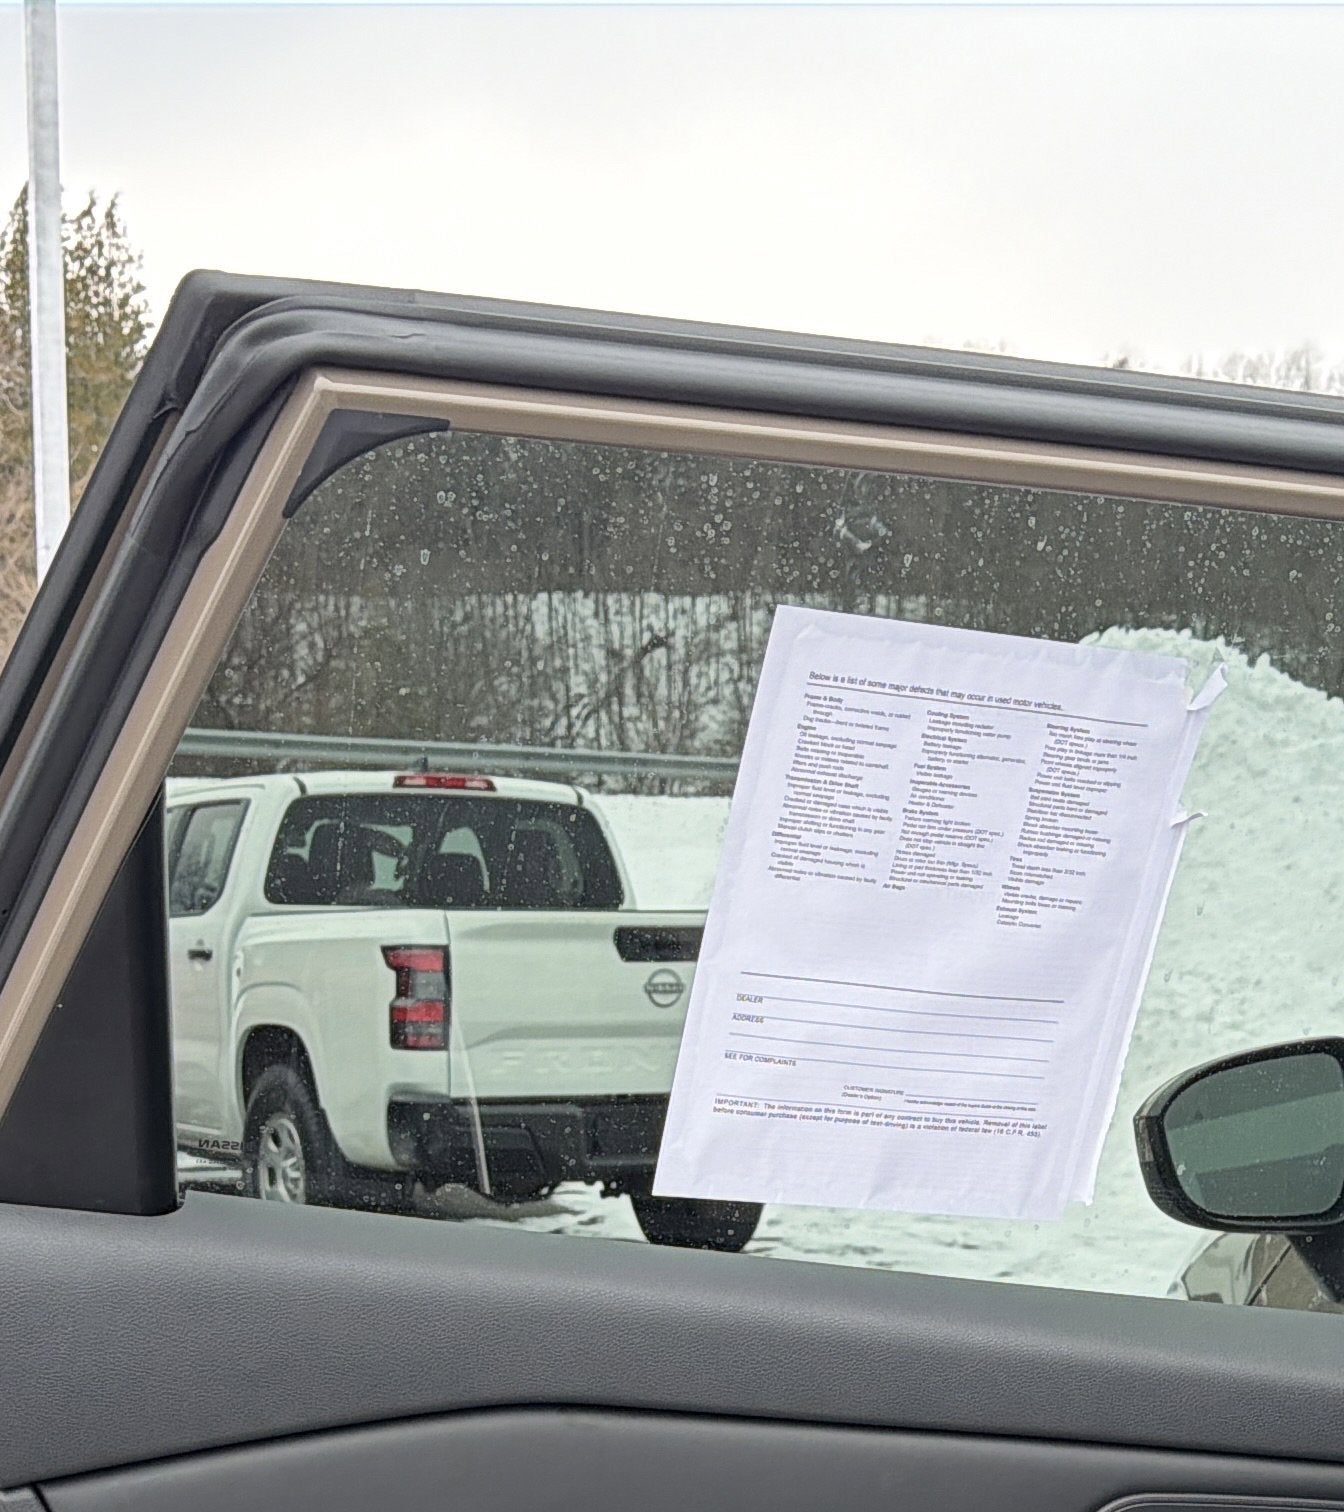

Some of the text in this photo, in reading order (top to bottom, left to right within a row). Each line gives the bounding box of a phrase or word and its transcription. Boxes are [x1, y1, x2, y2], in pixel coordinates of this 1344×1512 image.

[809, 671, 830, 680] Below
[847, 676, 858, 684] list
[888, 683, 907, 692] major
[909, 685, 933, 694] defects
[936, 688, 949, 696] that
[950, 691, 965, 700] may
[736, 995, 763, 1003] DEALER
[755, 1056, 796, 1066] COMPLAINTS
[713, 1106, 734, 1114] before
[715, 1098, 760, 1107] IMPORTANT:
[1011, 1122, 1018, 1130] of
